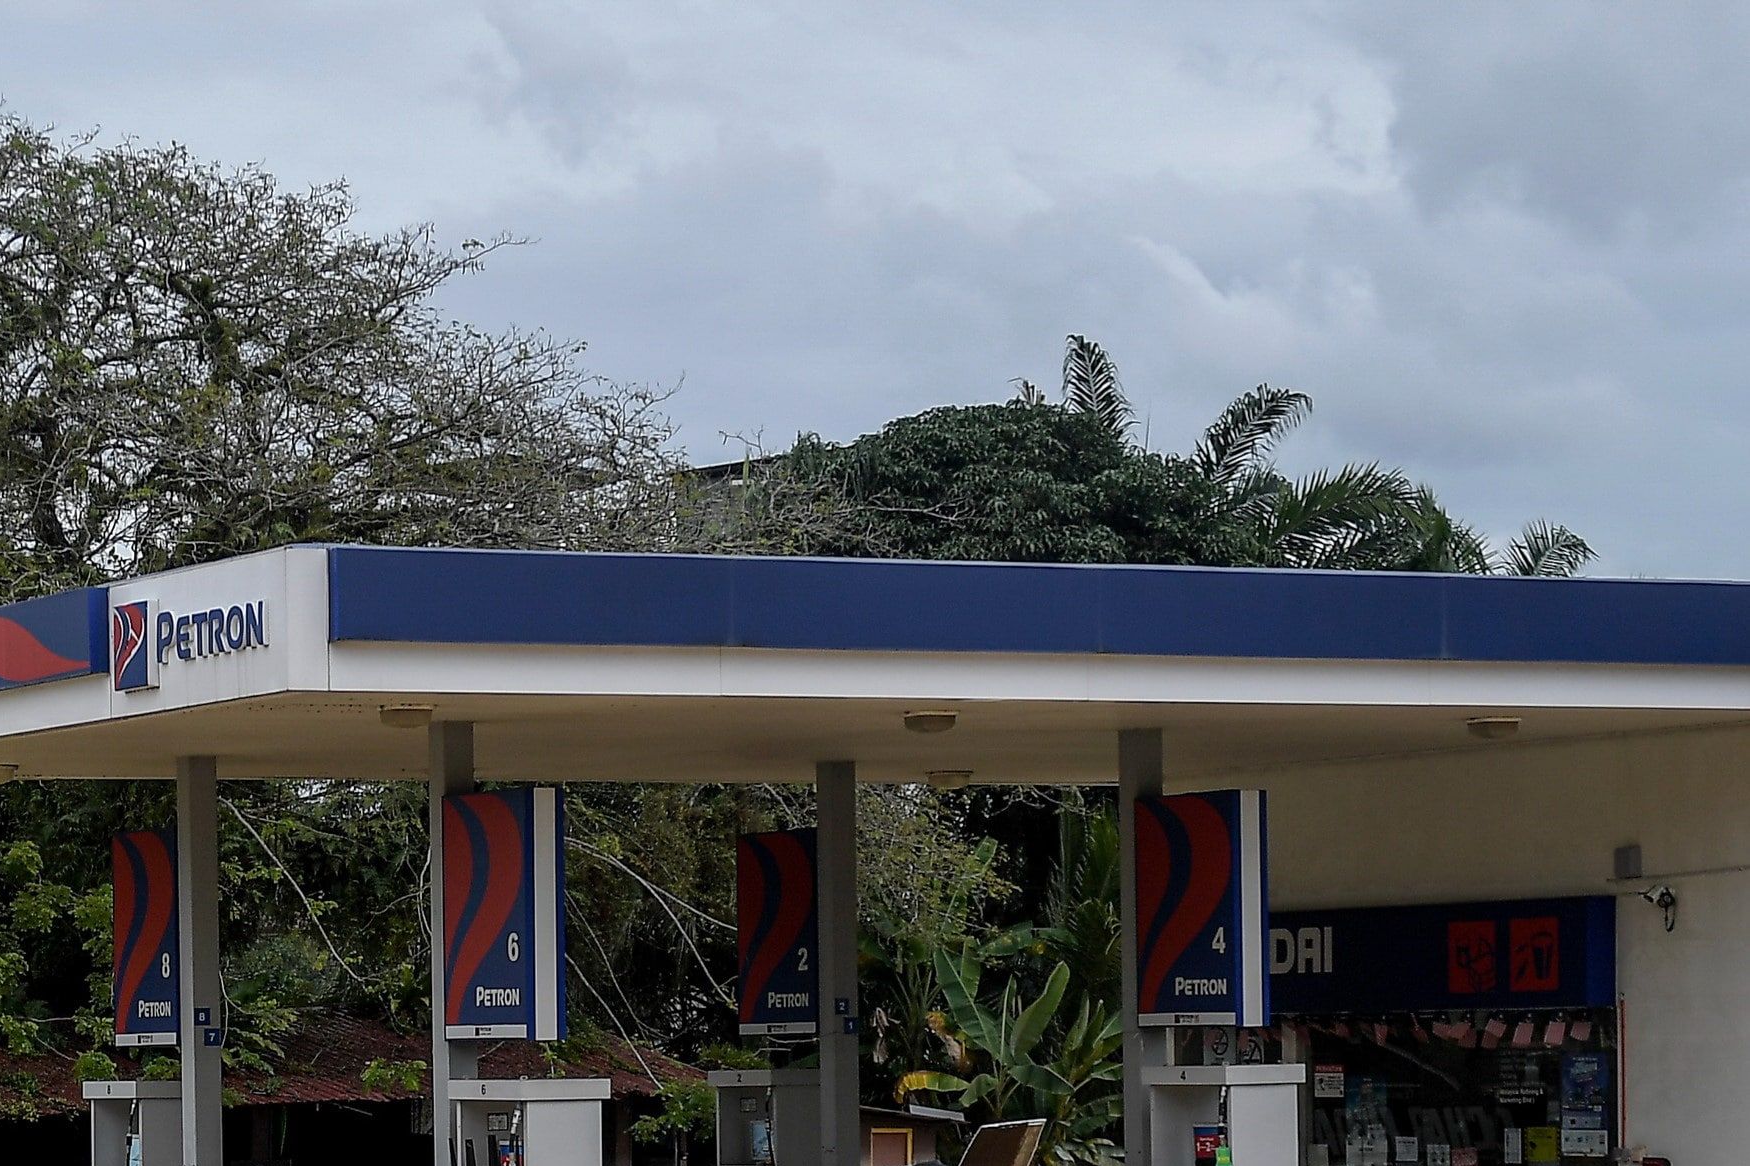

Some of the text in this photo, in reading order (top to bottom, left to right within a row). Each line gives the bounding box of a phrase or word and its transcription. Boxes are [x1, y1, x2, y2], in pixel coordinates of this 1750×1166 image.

[156, 600, 268, 665] PETRON
[507, 932, 520, 962] 6
[1211, 926, 1226, 954] 4
[161, 952, 170, 978] 8
[798, 947, 808, 971] 2
[1174, 976, 1227, 996] PETRON
[475, 986, 520, 1007] PETRON
[767, 992, 809, 1009] PETRON
[138, 999, 171, 1018] PETRON
[199, 1012, 205, 1022] 8
[209, 1032, 216, 1043] 7
[737, 1074, 742, 1082] 2
[1180, 1071, 1186, 1081] 4
[481, 1084, 486, 1095] 6
